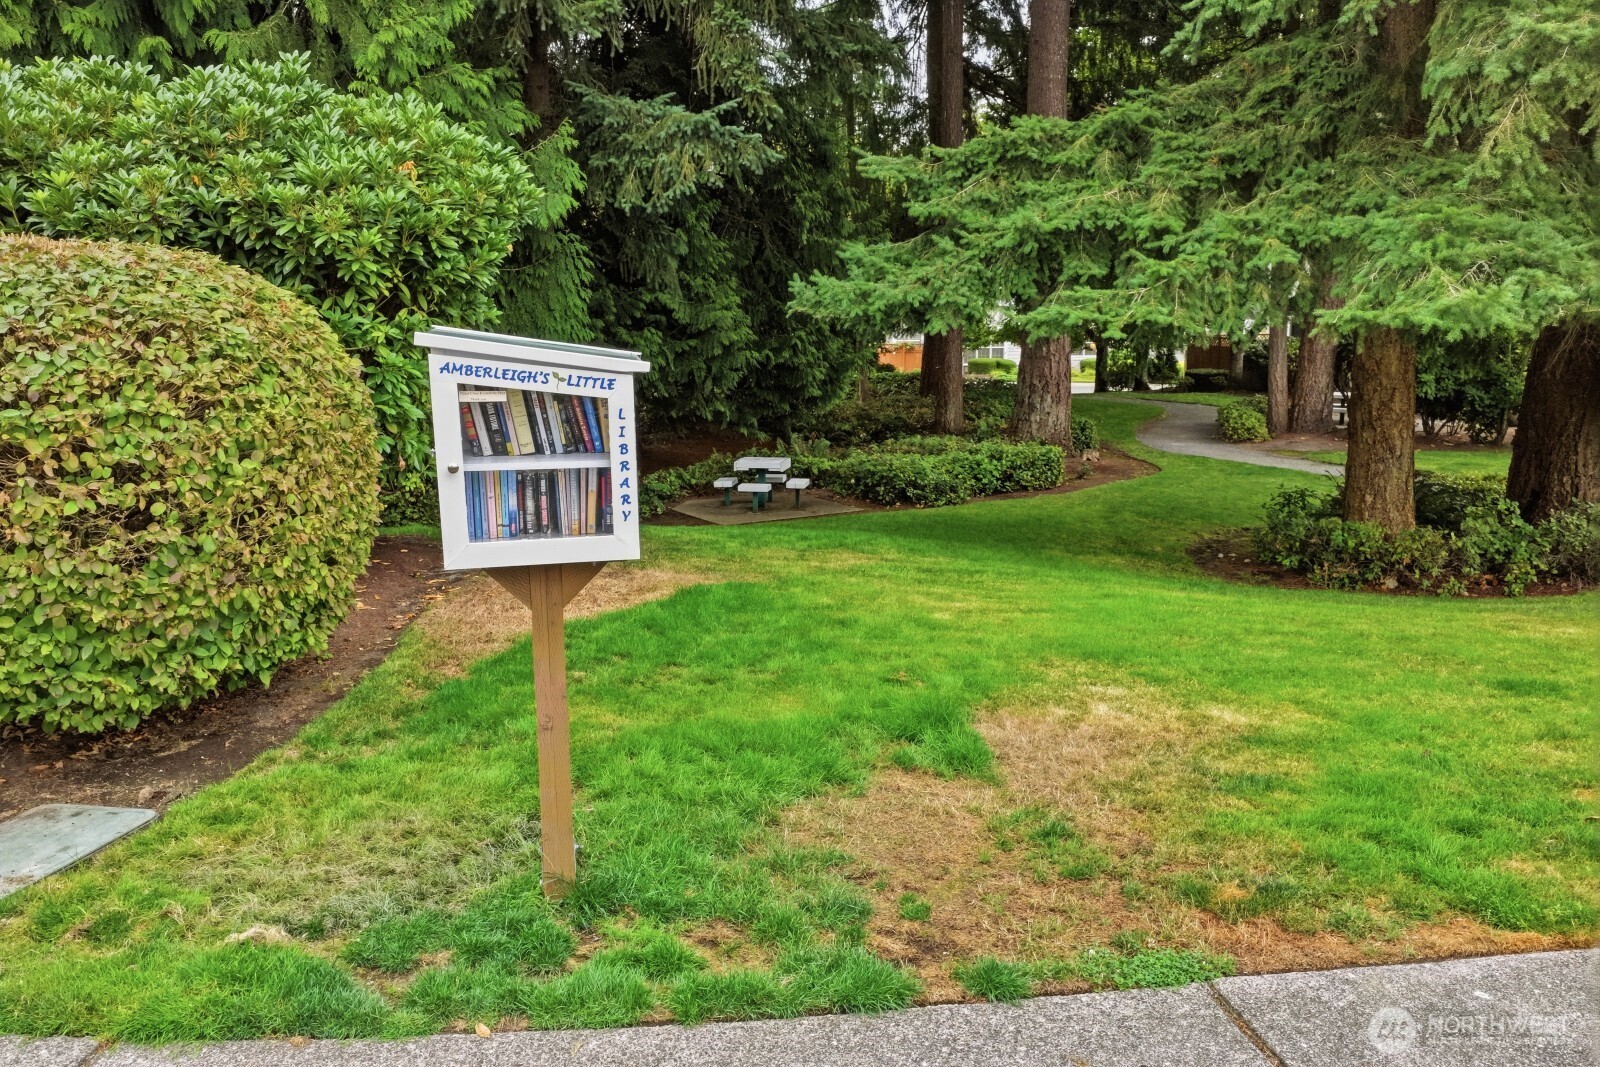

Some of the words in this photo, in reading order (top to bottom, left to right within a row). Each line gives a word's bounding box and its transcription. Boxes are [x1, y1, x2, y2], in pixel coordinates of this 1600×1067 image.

[439, 362, 550, 385] AMBERLEIGH'S
[566, 374, 616, 390] LITTLE
[618, 407, 632, 522] LIBRARY
